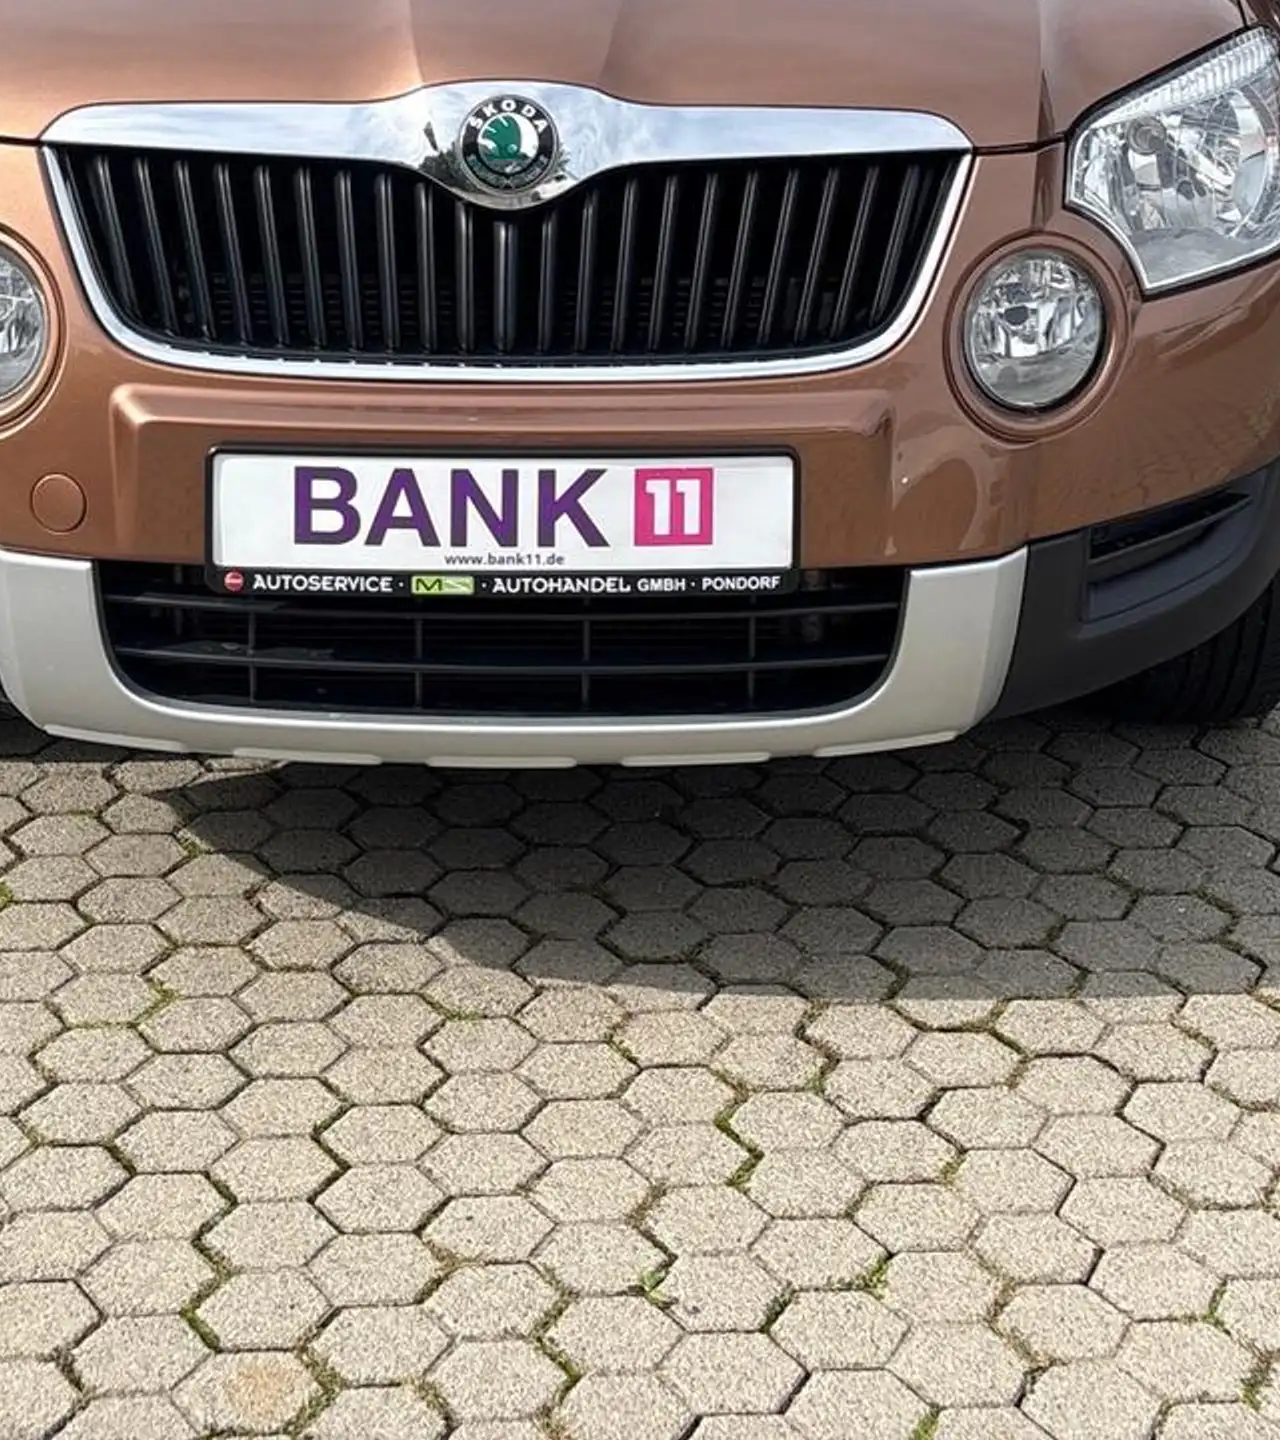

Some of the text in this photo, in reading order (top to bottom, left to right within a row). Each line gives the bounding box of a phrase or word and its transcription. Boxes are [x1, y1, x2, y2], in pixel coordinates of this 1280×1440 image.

[293, 465, 704, 548] BANK 11
[443, 553, 566, 566] www.bank11.de
[252, 573, 394, 593] AUTOSERVICE
[491, 577, 632, 594] AUTOHANDEL
[637, 578, 686, 592] GMBH
[701, 575, 781, 591] PONDORF
